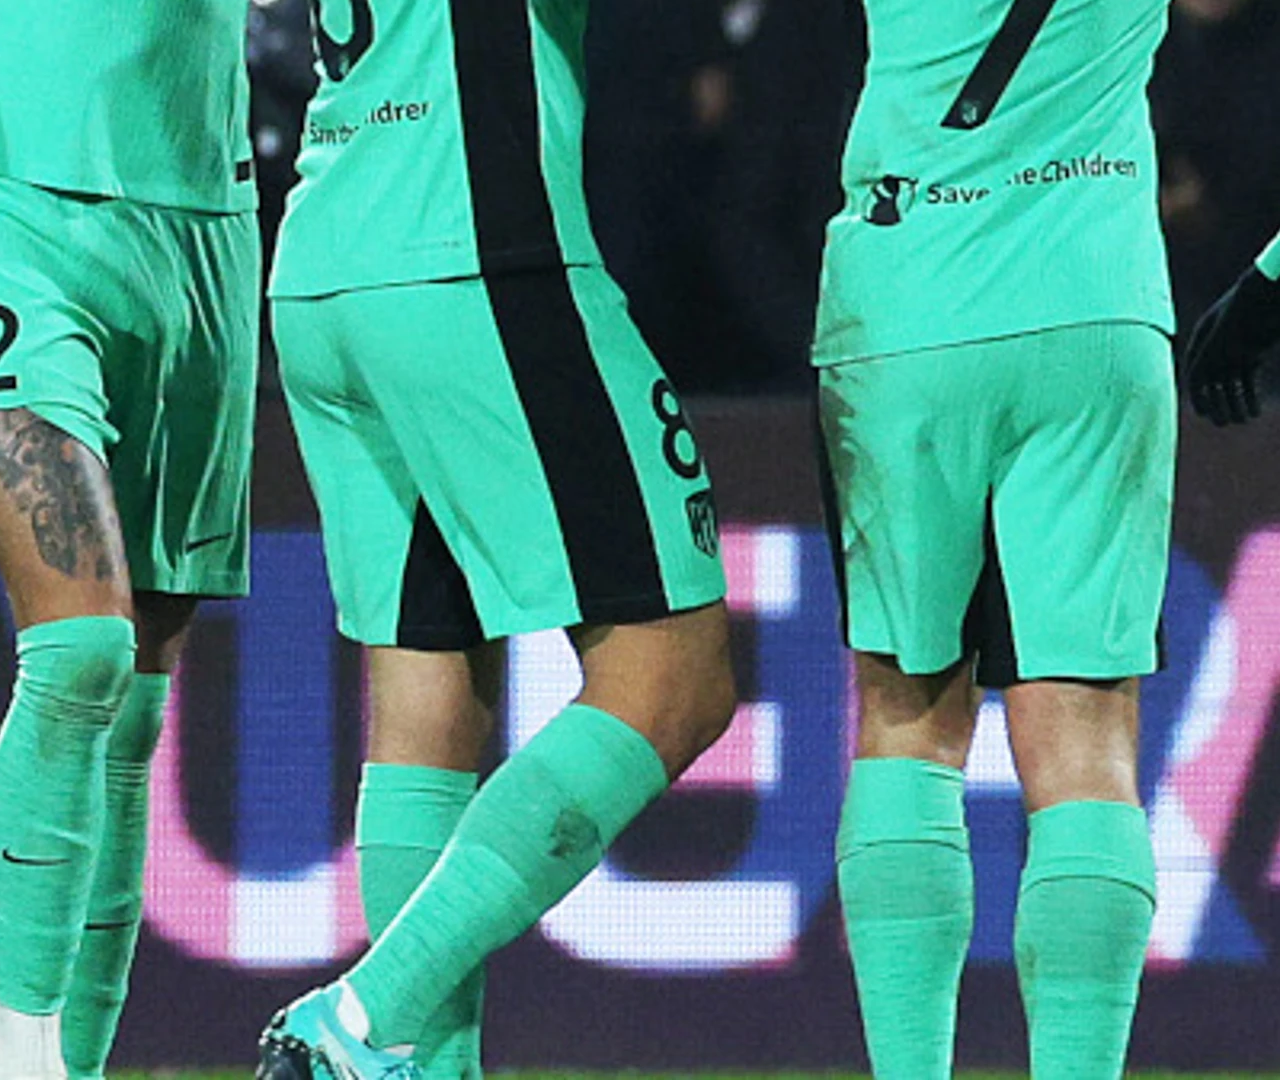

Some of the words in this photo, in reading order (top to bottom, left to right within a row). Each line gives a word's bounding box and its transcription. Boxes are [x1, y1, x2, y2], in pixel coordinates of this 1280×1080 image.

[926, 182, 991, 205] Save
[1040, 152, 1138, 183] Children
[652, 378, 701, 479] 8
